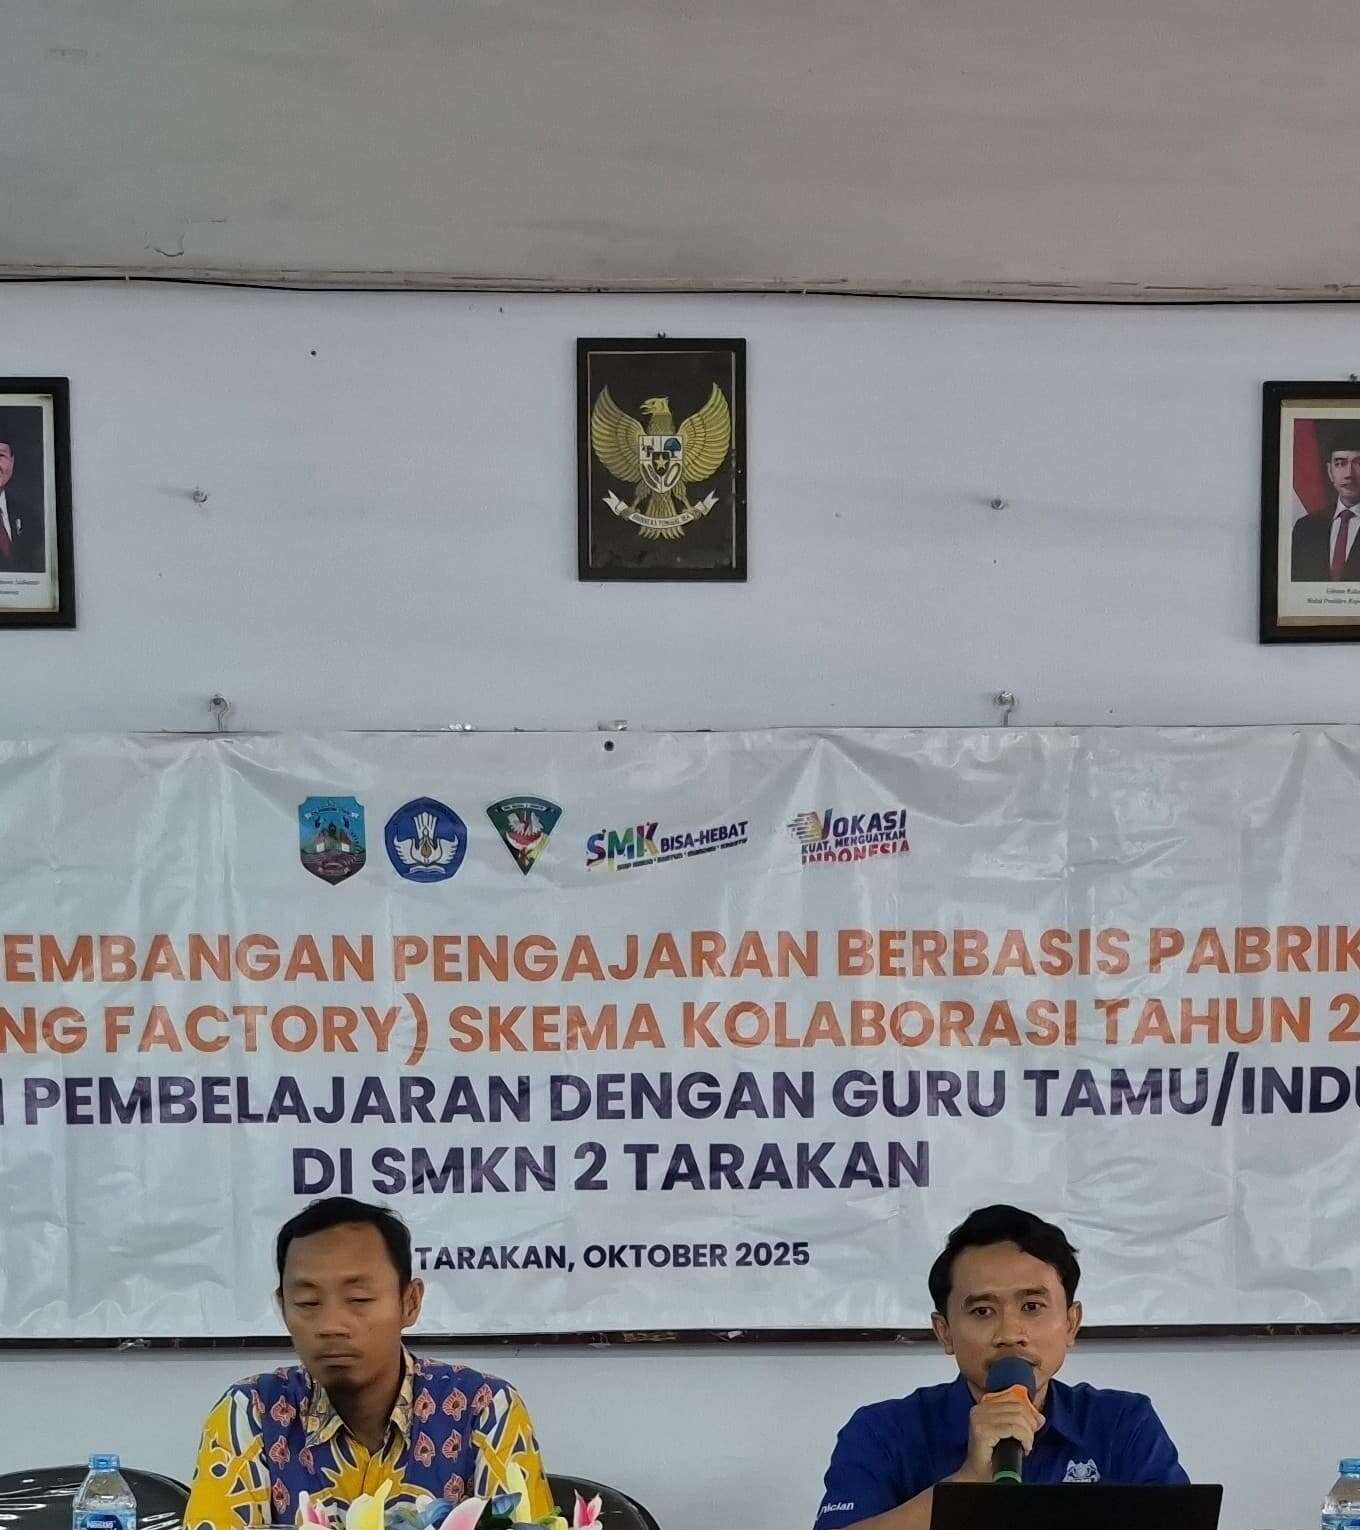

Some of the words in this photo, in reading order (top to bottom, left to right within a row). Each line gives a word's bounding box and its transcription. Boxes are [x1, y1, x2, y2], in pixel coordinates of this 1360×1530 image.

[586, 822, 659, 868] SMK
[660, 821, 749, 853] BISA-HEBAT
[395, 931, 819, 983] PENGAJARAN
[837, 928, 1129, 978] BERBASIS
[104, 992, 429, 1066] FACTORY)
[448, 1002, 665, 1054] SKEMA
[682, 999, 1078, 1050] KOLABORASI
[1096, 996, 1312, 1047] TAHUN
[23, 1075, 531, 1126] PEMBELAJARAN
[549, 1071, 816, 1122] DENGAN
[832, 1069, 1007, 1119] GURU
[292, 1147, 353, 1195] DI
[371, 1145, 556, 1195] SMKN
[574, 1141, 609, 1191] 2
[623, 1140, 930, 1191] TARAKAN
[414, 1245, 575, 1273] TARAKAN,
[582, 1243, 728, 1269] OKTOBER
[735, 1242, 811, 1267] 2025
